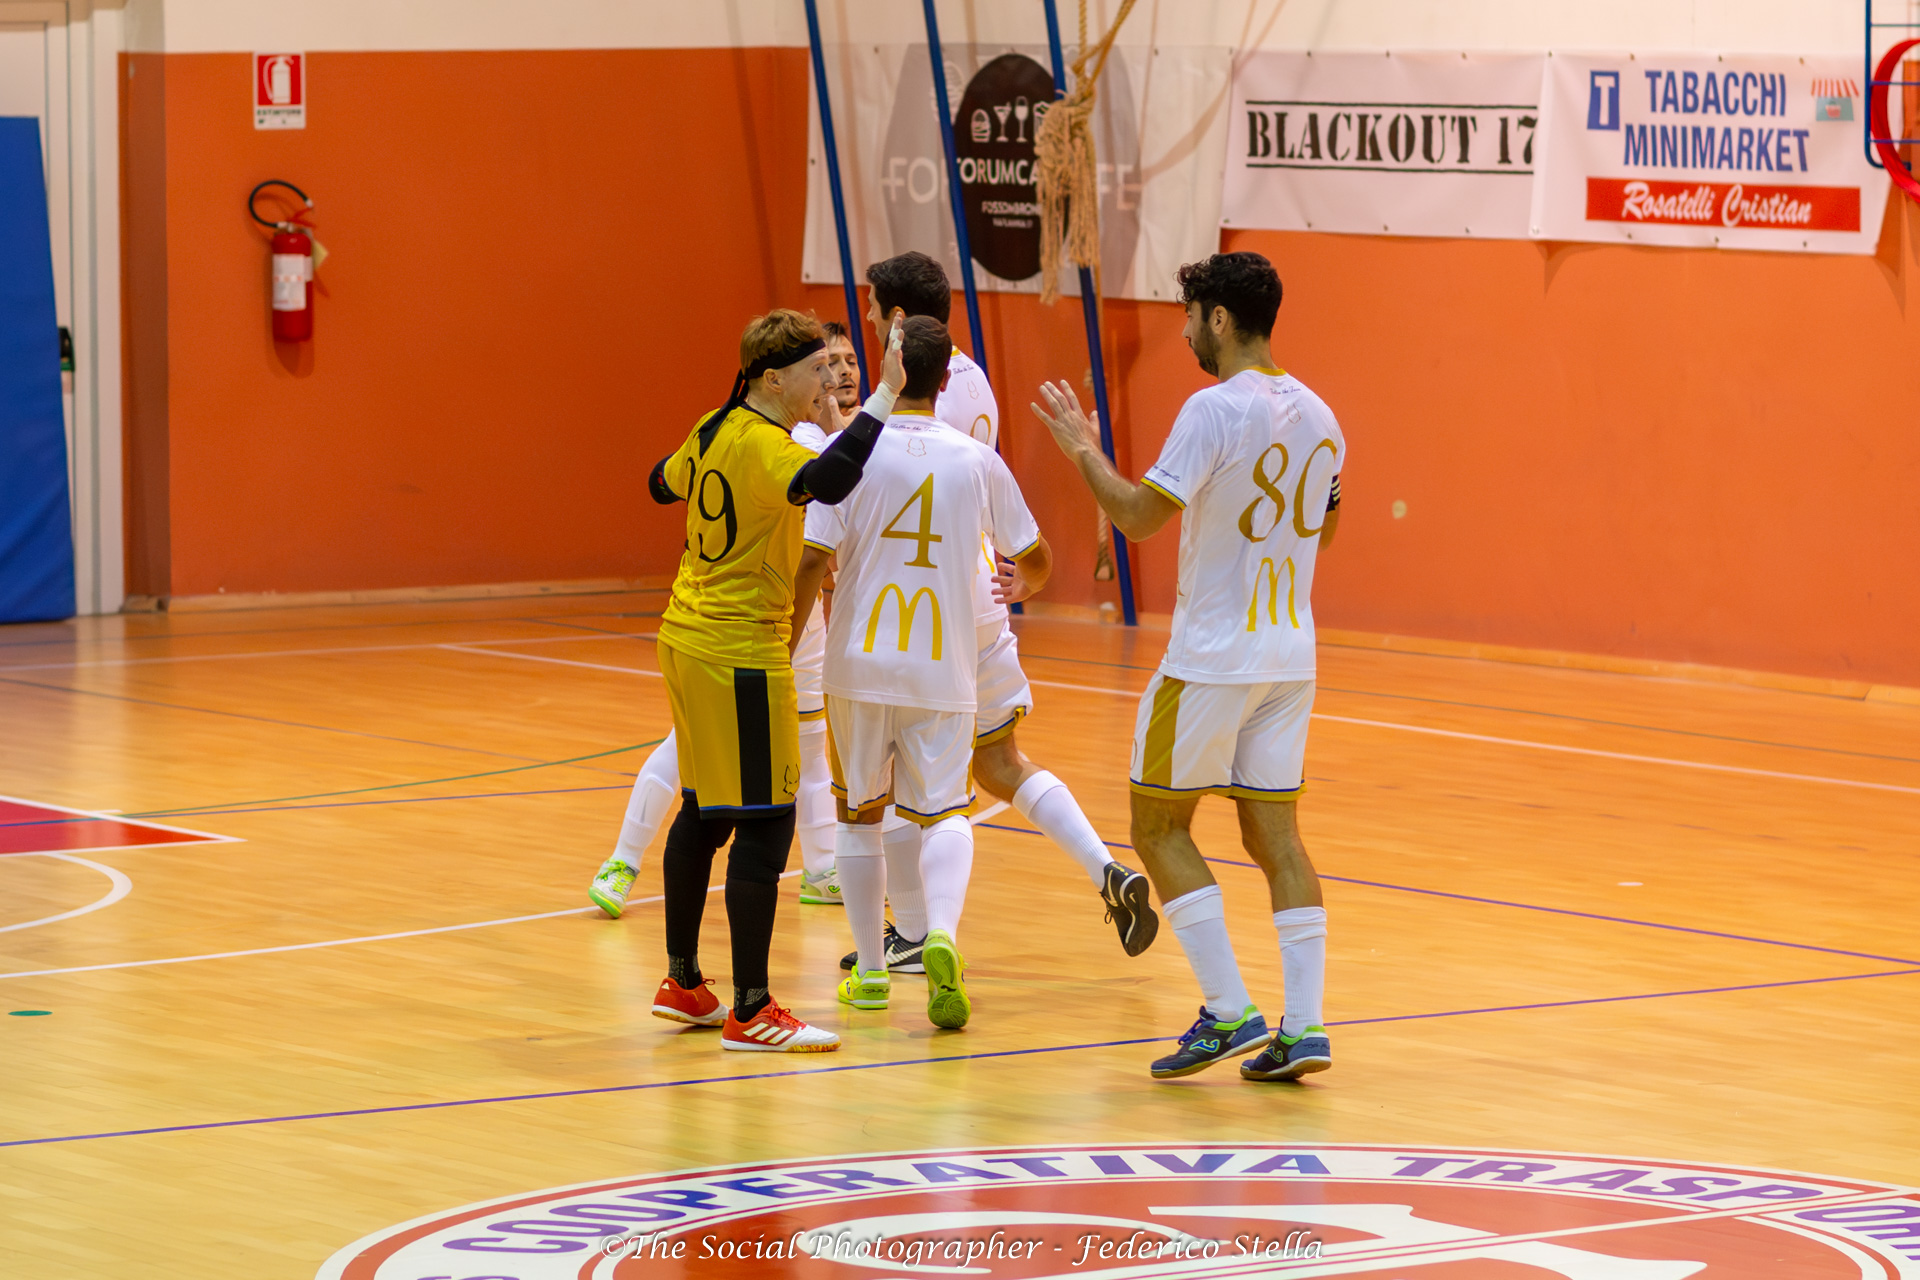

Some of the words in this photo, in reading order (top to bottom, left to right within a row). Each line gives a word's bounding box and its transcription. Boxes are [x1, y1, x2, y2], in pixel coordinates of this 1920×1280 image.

[1645, 70, 1786, 117] TABACCHI
[1247, 111, 1477, 164] BLACKOUT
[1498, 115, 1537, 165] 17
[1623, 123, 1809, 172] MINIMARKET
[1621, 181, 1715, 220] Rosatelli
[1721, 183, 1812, 228] Cristian
[880, 473, 942, 568] 4
[442, 1153, 1331, 1254] COOPERATIVA
